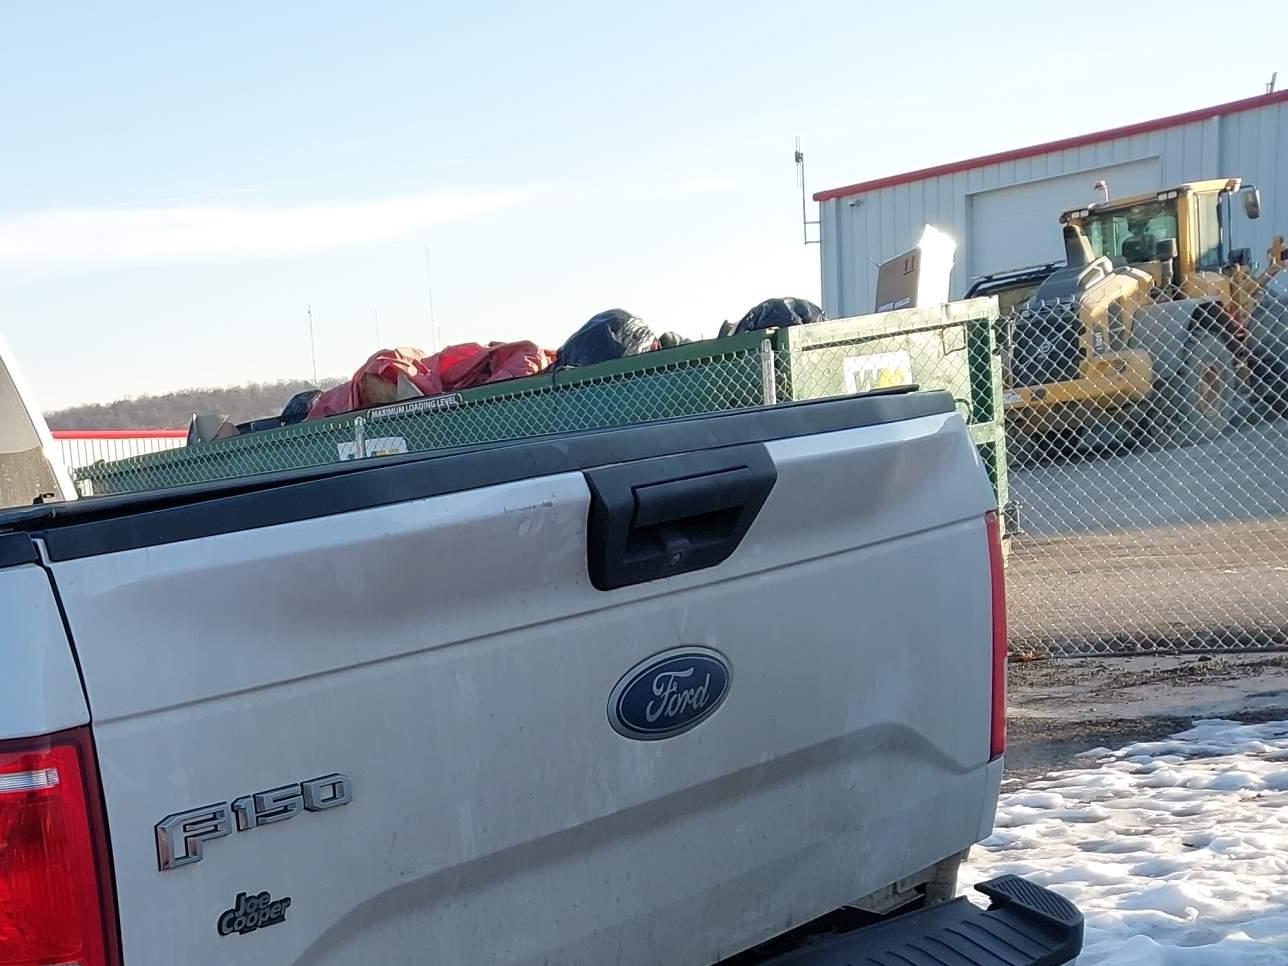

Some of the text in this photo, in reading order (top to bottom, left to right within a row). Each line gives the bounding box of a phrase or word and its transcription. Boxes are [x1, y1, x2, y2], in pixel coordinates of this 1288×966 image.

[372, 396, 457, 418] MAXIMUM LOADING LEVEL
[646, 667, 711, 722] Ford
[218, 897, 291, 936] Cooper
[235, 891, 271, 916] Joe
